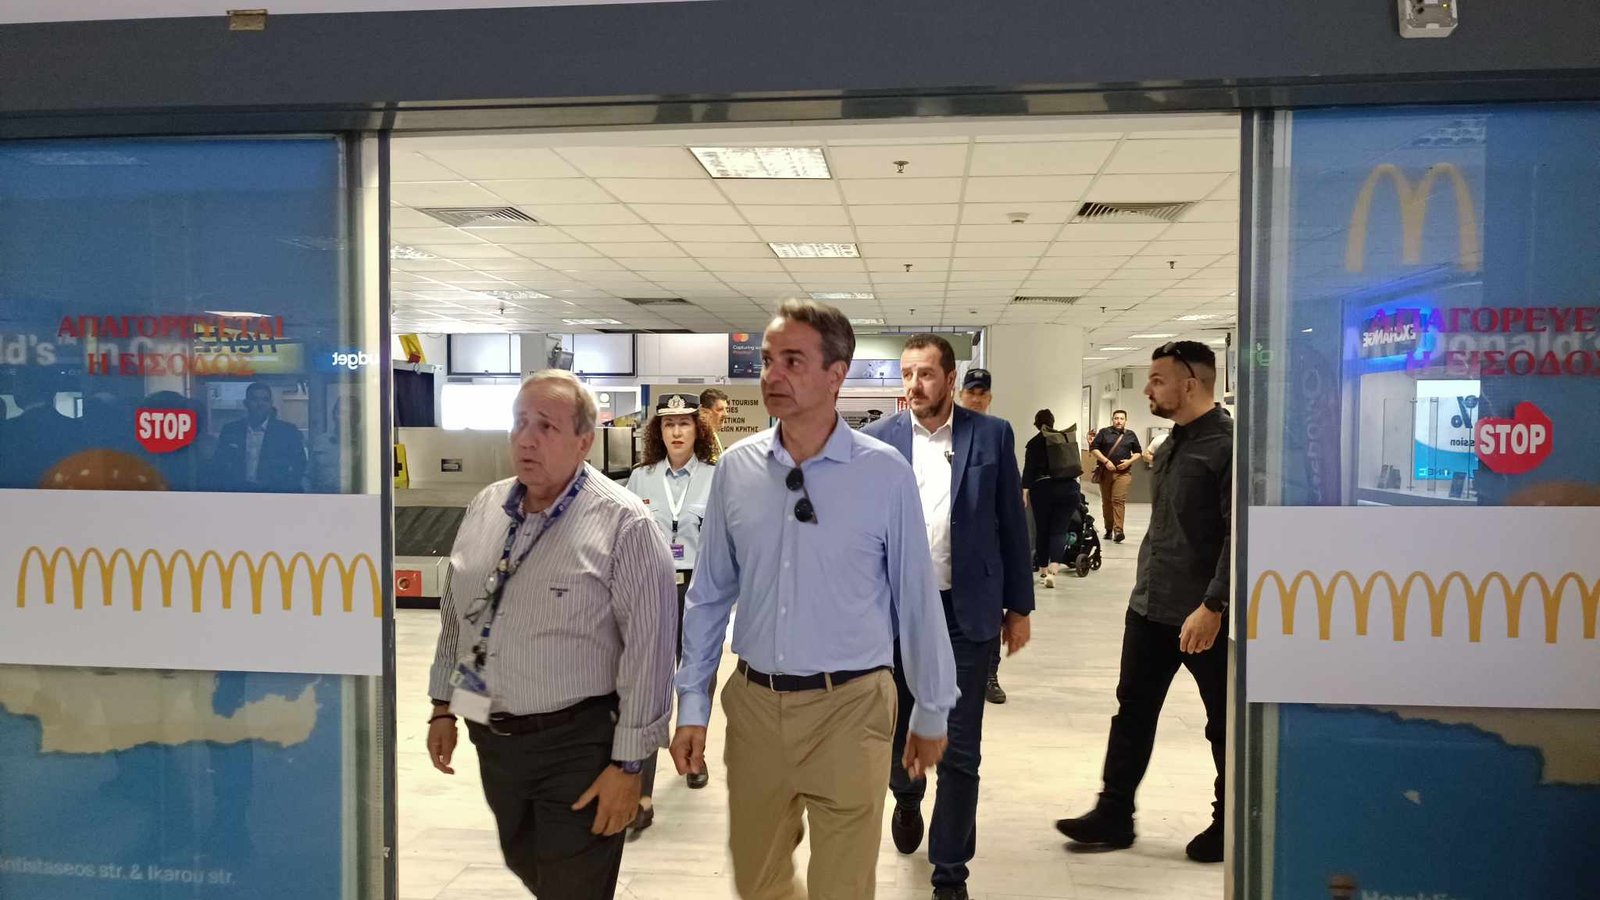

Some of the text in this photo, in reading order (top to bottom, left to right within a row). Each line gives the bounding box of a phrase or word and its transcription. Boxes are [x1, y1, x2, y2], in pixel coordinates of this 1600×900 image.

[57, 315, 284, 339] ΑΠΑΓΟΡΕΥΕΤΑΙ
[1370, 307, 1600, 333] ΑΠΑΓΟΡΕΥΕ
[1445, 350, 1600, 376] ΕΙΣΟΔΟ
[139, 412, 192, 440] STOP
[1479, 423, 1547, 455] STOP
[0, 855, 96, 878] ntistaseos
[129, 864, 143, 880] &
